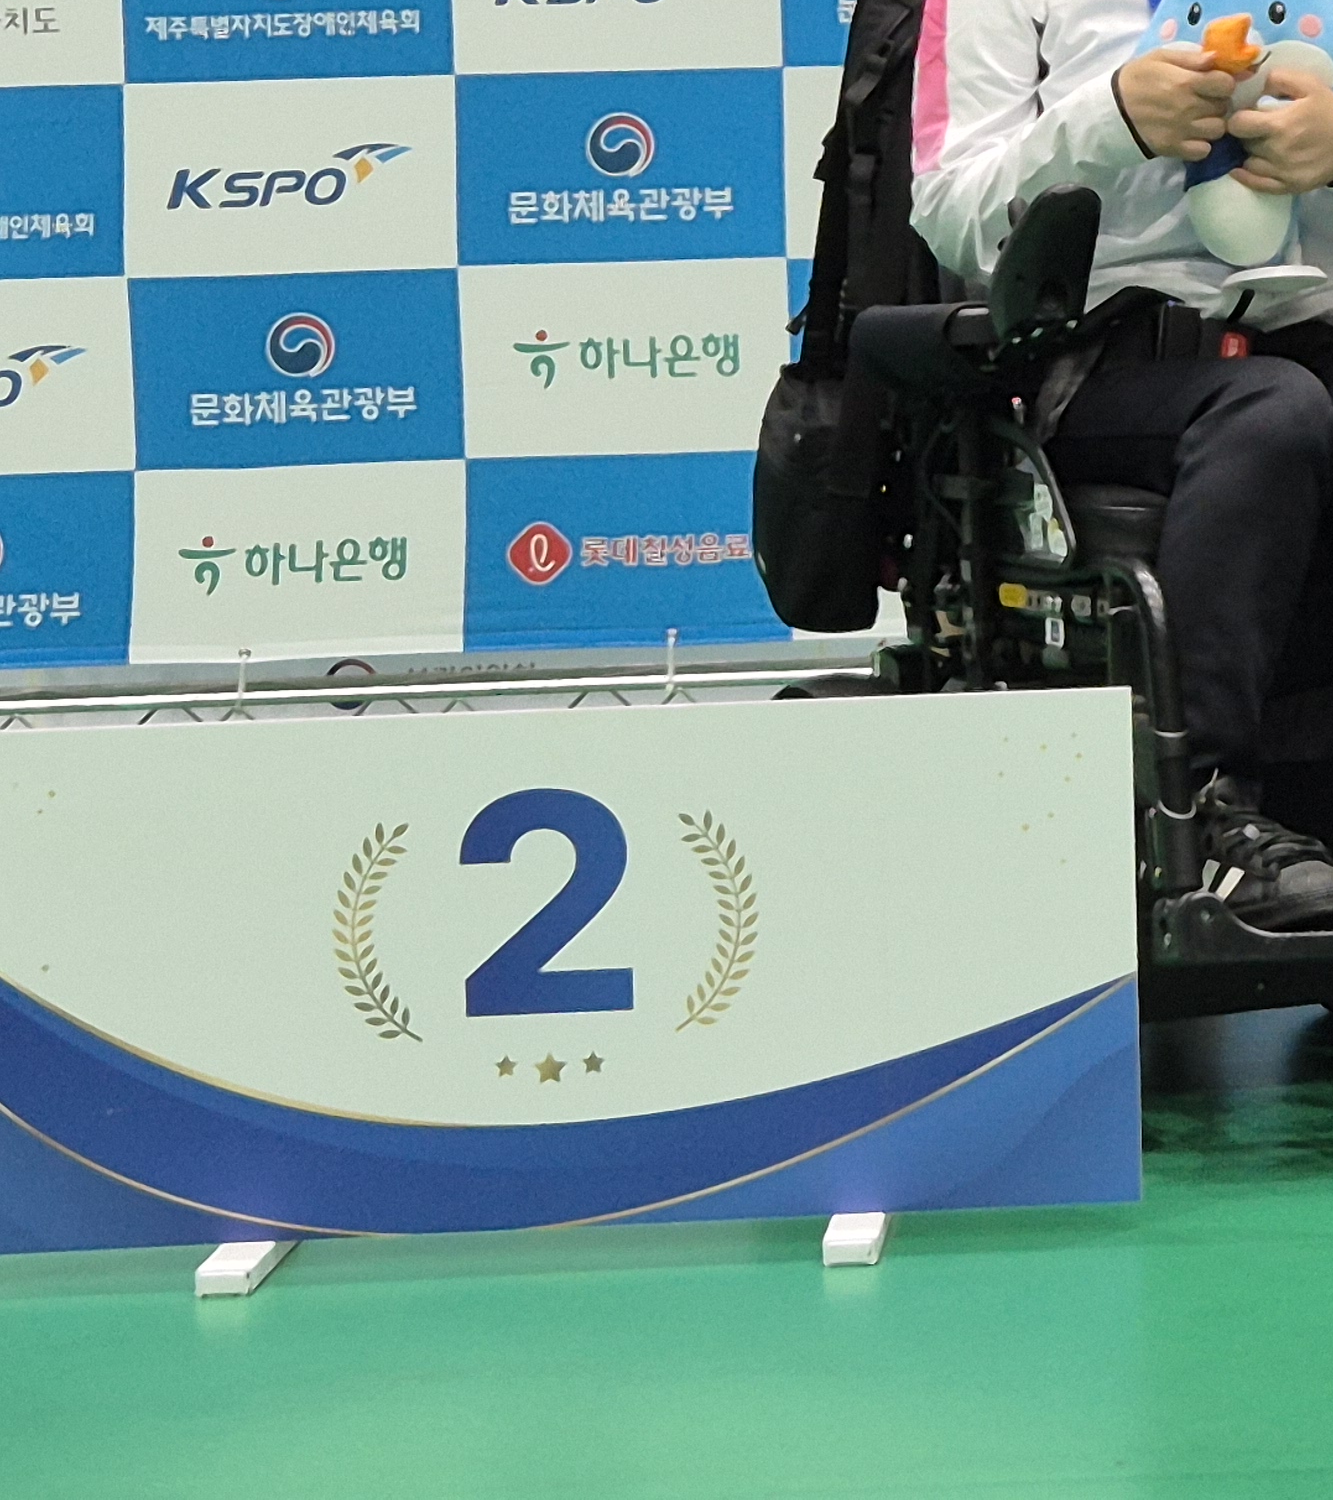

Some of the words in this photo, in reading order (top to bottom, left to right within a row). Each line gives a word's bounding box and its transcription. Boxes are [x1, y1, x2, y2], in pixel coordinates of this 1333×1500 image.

[144, 8, 420, 41] 제주특별자치도장애인체육회
[166, 167, 348, 211] KSPO
[508, 186, 734, 224] 문화체육관광부
[578, 332, 740, 380] 하나은행
[189, 386, 418, 426] 문화체육관광부
[244, 536, 408, 586] 하나은행
[578, 534, 753, 568] 롯데칠성음료
[458, 787, 634, 1018] 2
